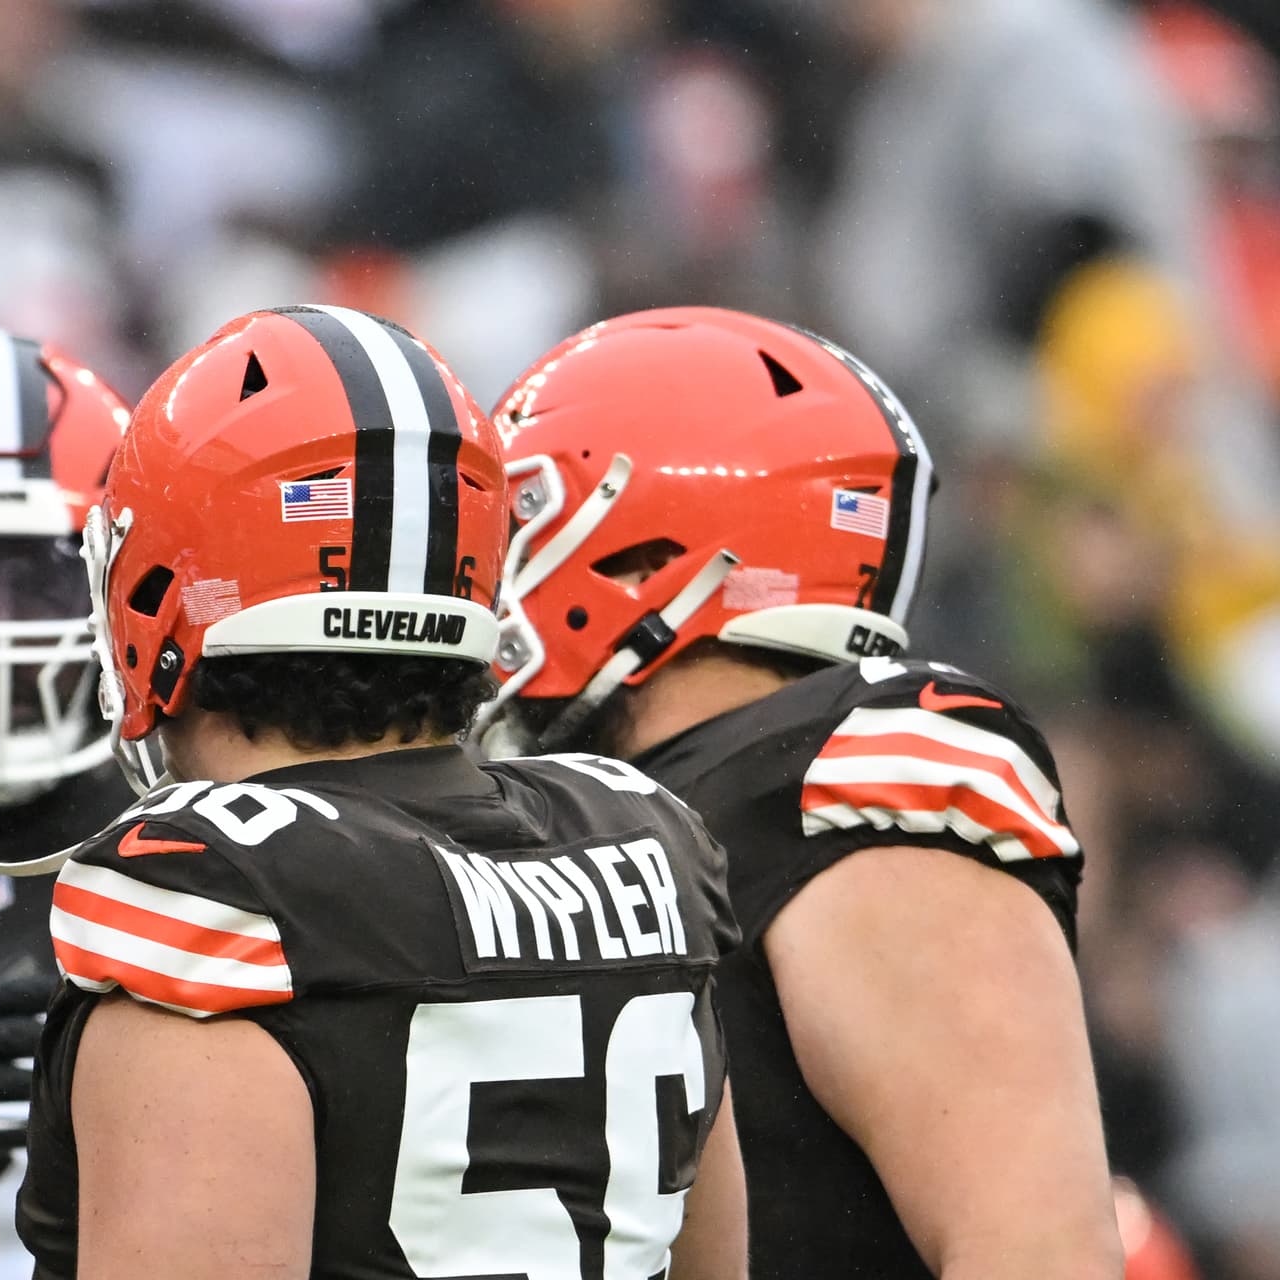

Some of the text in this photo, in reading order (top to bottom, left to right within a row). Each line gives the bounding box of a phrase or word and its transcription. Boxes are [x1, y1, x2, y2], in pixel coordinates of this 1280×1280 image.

[320, 546, 476, 601] 5 6
[324, 607, 467, 645] CLEVELAND
[435, 837, 687, 961] WYPLER
